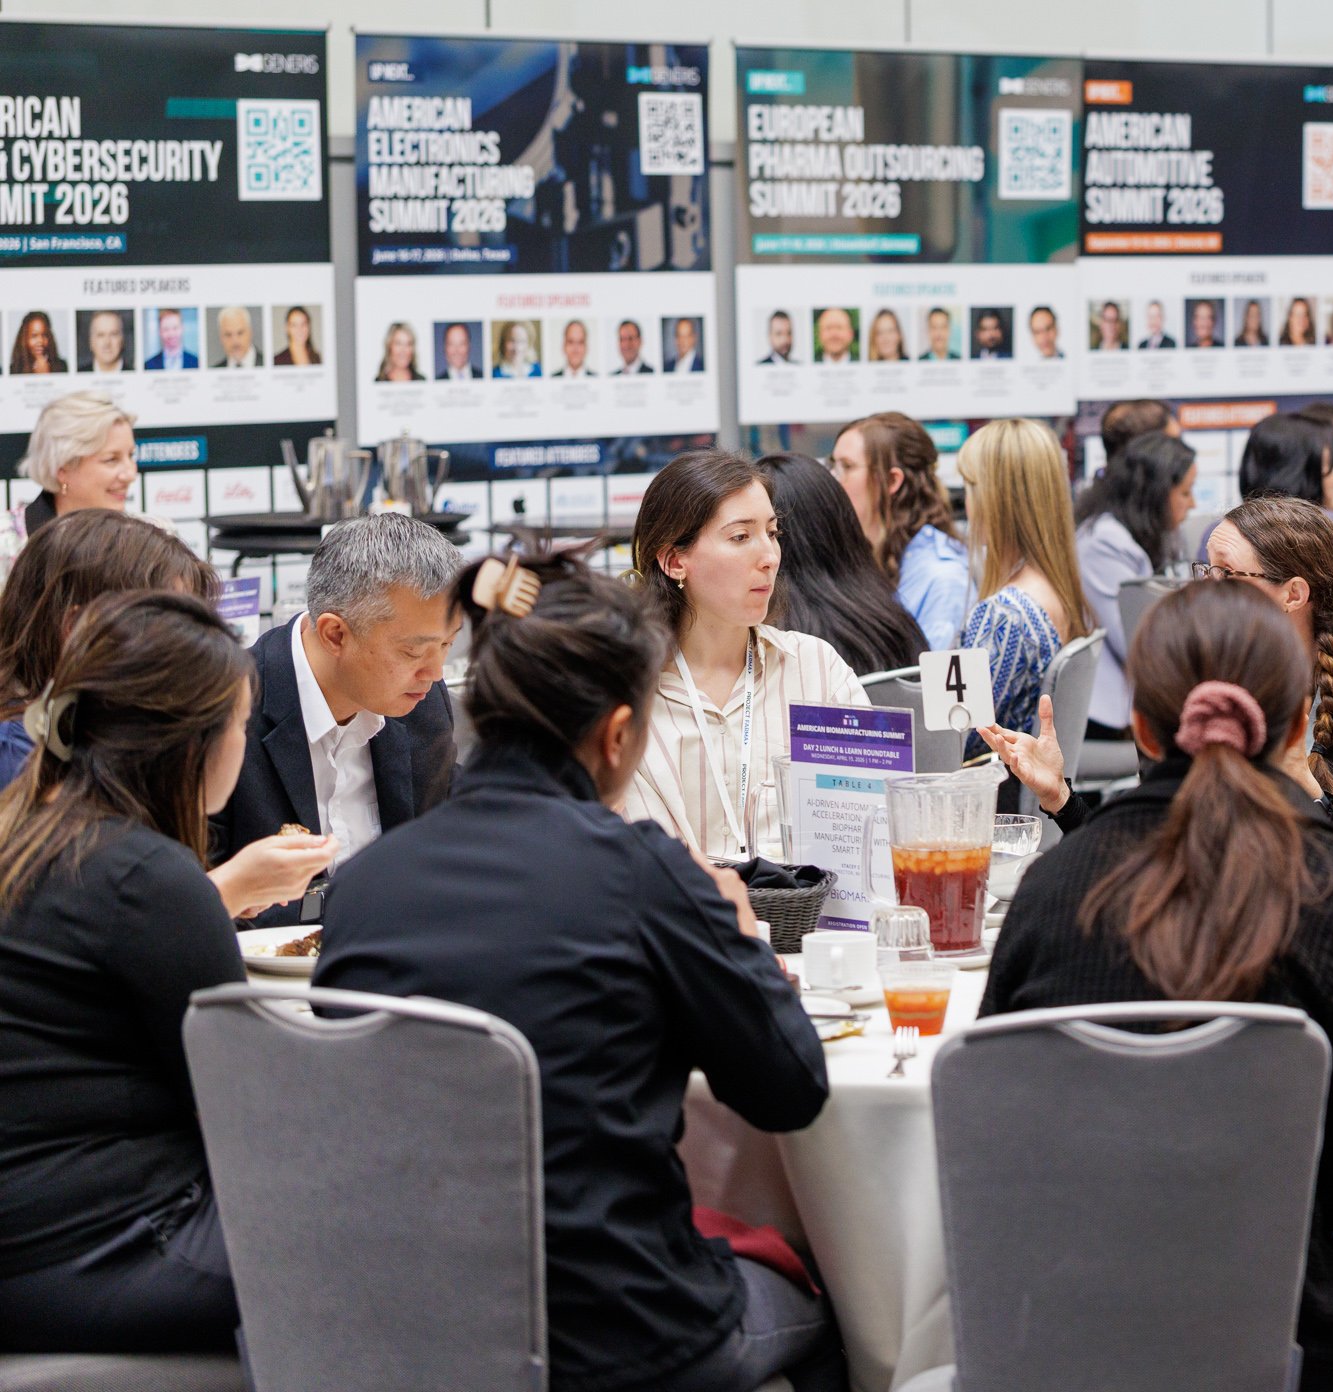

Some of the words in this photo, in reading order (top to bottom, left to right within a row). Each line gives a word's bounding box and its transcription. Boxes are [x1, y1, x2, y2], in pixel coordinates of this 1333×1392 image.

[367, 97, 472, 130] AMERICAN
[748, 105, 864, 141] EUROPEAN
[1084, 112, 1191, 149] AMERICAN
[12, 140, 223, 182] CYBERSECURITY
[368, 131, 501, 165] ELECTRONICS
[749, 143, 842, 180] PHARMA
[844, 145, 985, 181] OUTSOURCING
[369, 165, 535, 198] MANUFACTURING
[1084, 150, 1214, 186] AUTOMOTIVE
[55, 183, 129, 225] 2026
[369, 199, 449, 232] SUMMIT
[451, 200, 506, 232] 2026
[749, 182, 839, 217] SUMMIT
[842, 183, 901, 218] 2026
[1084, 187, 1166, 224] SUMMIT
[1167, 187, 1224, 224] 2026
[29, 236, 50, 250] San
[84, 278, 136, 294] FEATURED
[139, 277, 191, 293] SPEAKERS
[945, 655, 967, 702] 4
[797, 724, 826, 733] AMERICAN
[826, 726, 882, 738] BIOMANUFACTURING
[883, 731, 905, 739] SUMMIT
[845, 747, 862, 755] LEARN
[863, 749, 900, 758] ROUNDTABLE
[832, 779, 861, 788] TABLE
[807, 798, 839, 808] AI-DRIVEN
[812, 810, 862, 822] ACCELERATION:
[832, 822, 862, 832] BIOPHAR
[832, 844, 854, 853] SMART
